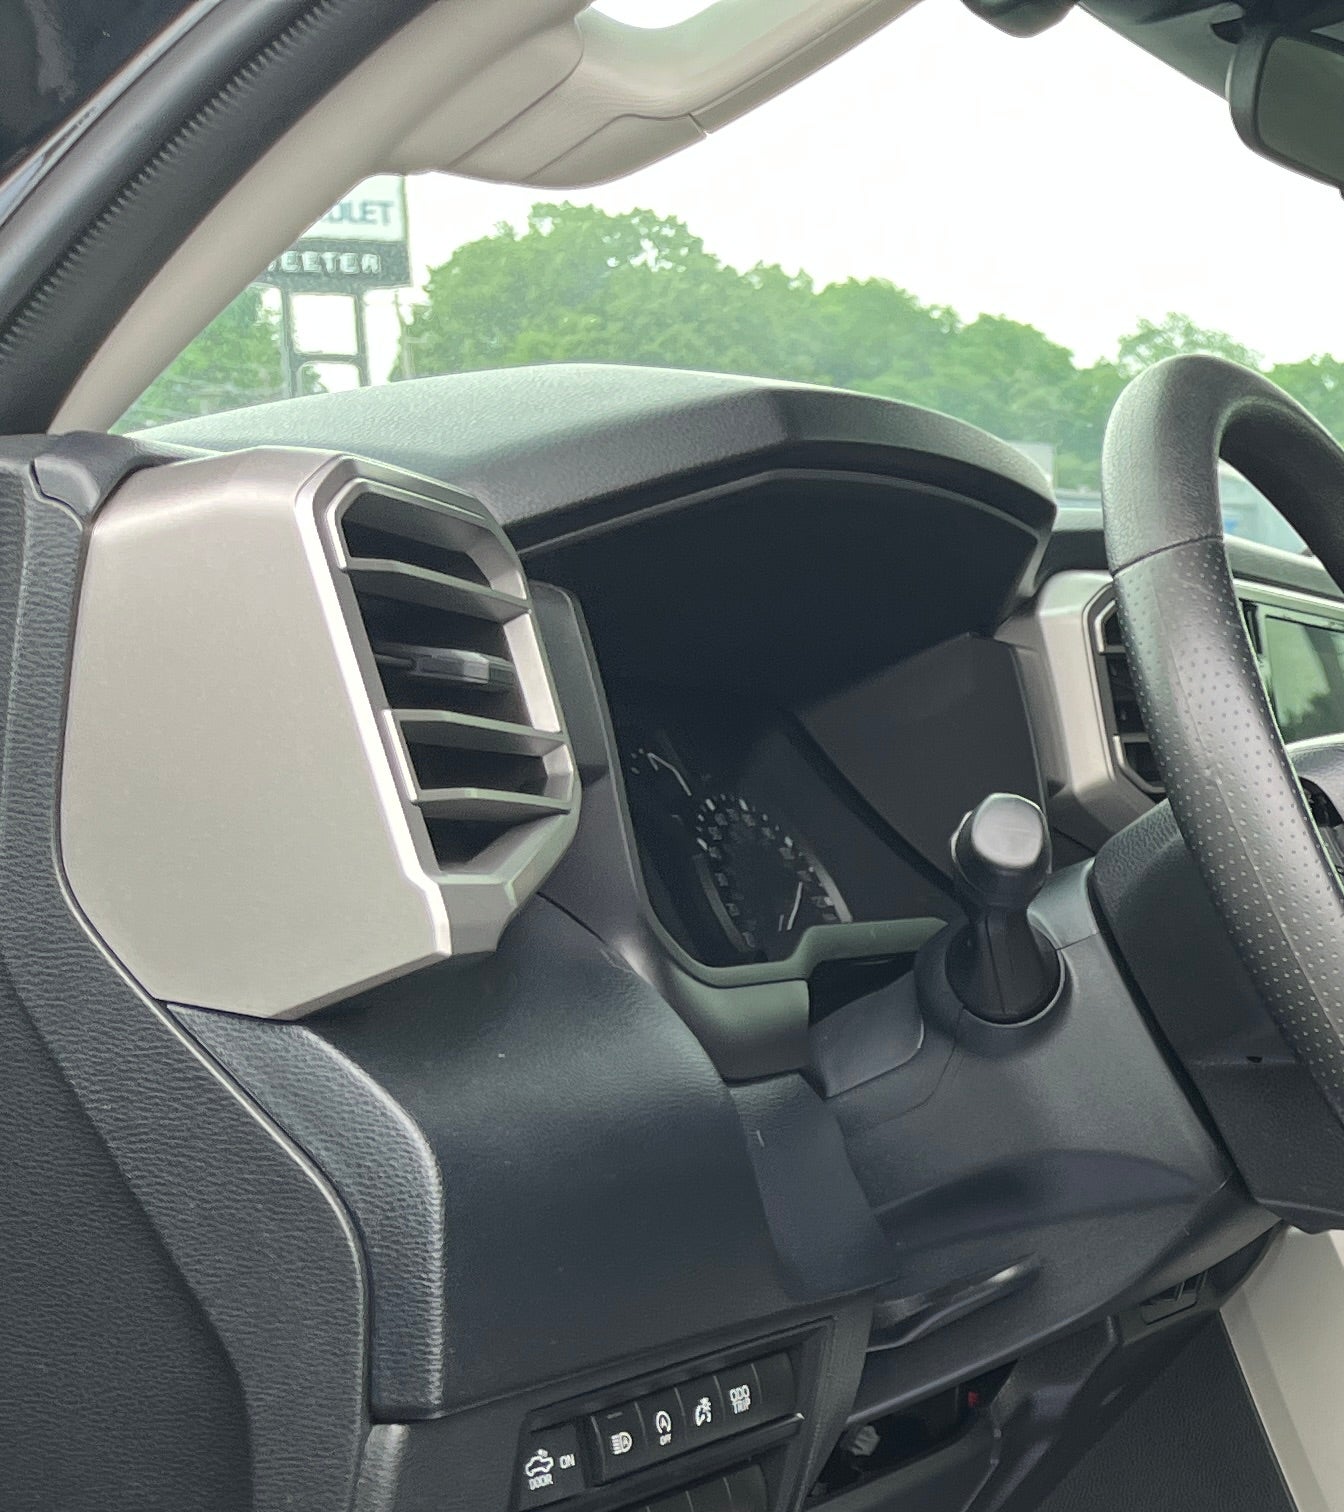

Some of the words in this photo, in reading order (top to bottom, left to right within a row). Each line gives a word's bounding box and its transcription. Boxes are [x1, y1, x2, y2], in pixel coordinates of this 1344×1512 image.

[268, 250, 381, 274] EETER
[729, 1385, 750, 1400] ODO
[559, 1453, 576, 1469] ON
